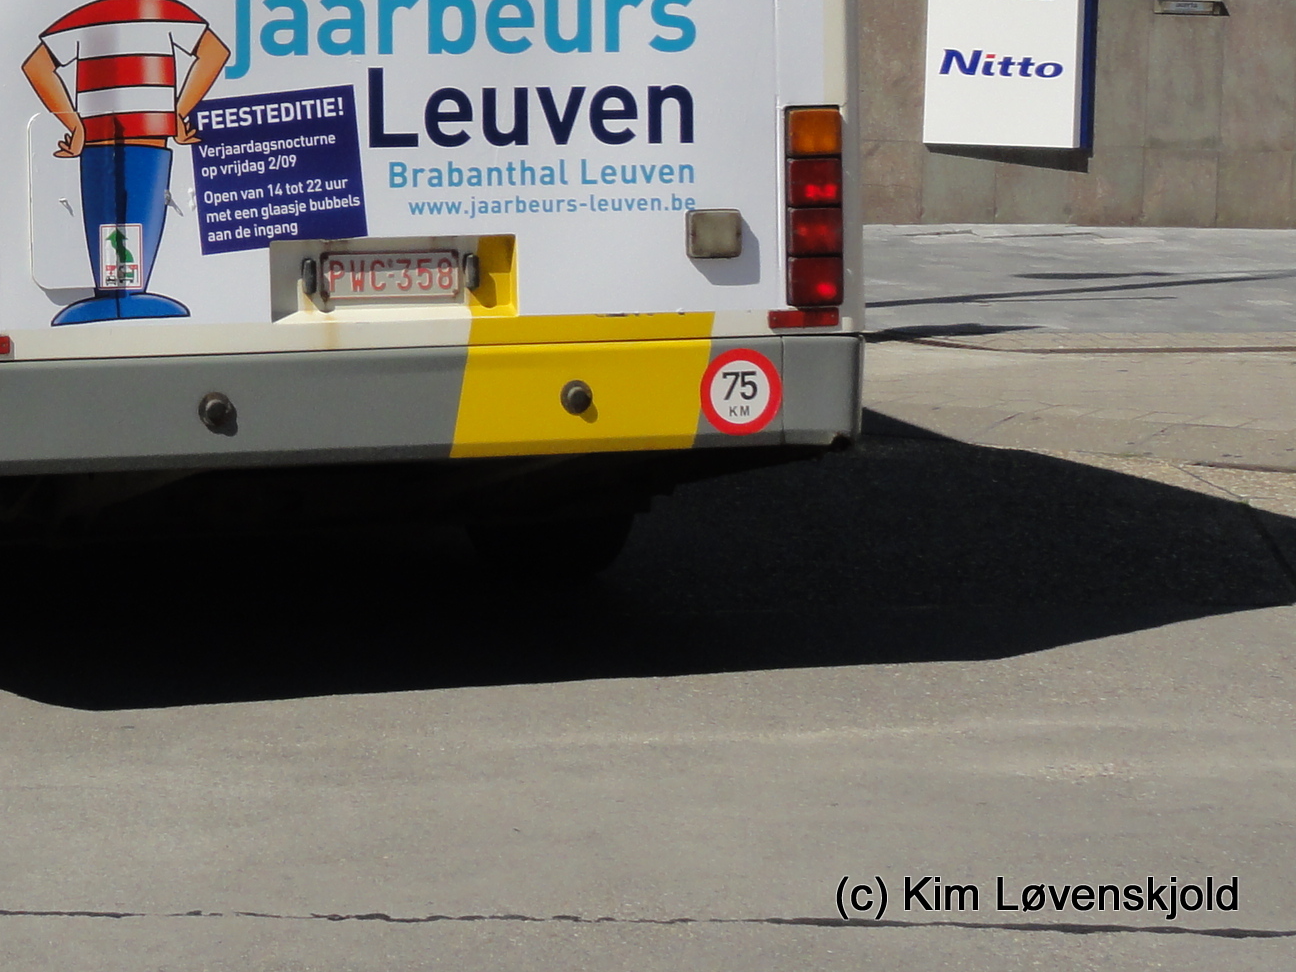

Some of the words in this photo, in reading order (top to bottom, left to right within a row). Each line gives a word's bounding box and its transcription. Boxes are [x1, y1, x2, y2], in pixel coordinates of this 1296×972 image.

[939, 48, 1064, 78] Nitto
[196, 97, 344, 131] FEESTEDITIE!
[368, 67, 694, 148] Leuven
[199, 134, 336, 159] Verjaardagsnocturne
[201, 166, 217, 179] op
[220, 160, 265, 177] vrijdag
[268, 155, 297, 170] 2/09
[388, 159, 568, 188] Brabanthal
[580, 158, 695, 186] Leuven
[204, 189, 238, 206] Open
[240, 187, 264, 200] van
[267, 183, 283, 197] 14
[285, 182, 303, 196] tot
[306, 179, 322, 193] 22
[325, 178, 348, 191] uur
[408, 194, 696, 219] www.jaarbeurs-leuven.be
[206, 209, 232, 223] met
[234, 207, 258, 220] een
[261, 200, 307, 220] glaasje
[309, 194, 361, 212] bubbels
[207, 229, 232, 242] aan
[235, 226, 251, 239] de
[254, 222, 298, 239] ingang
[722, 371, 758, 400] 75
